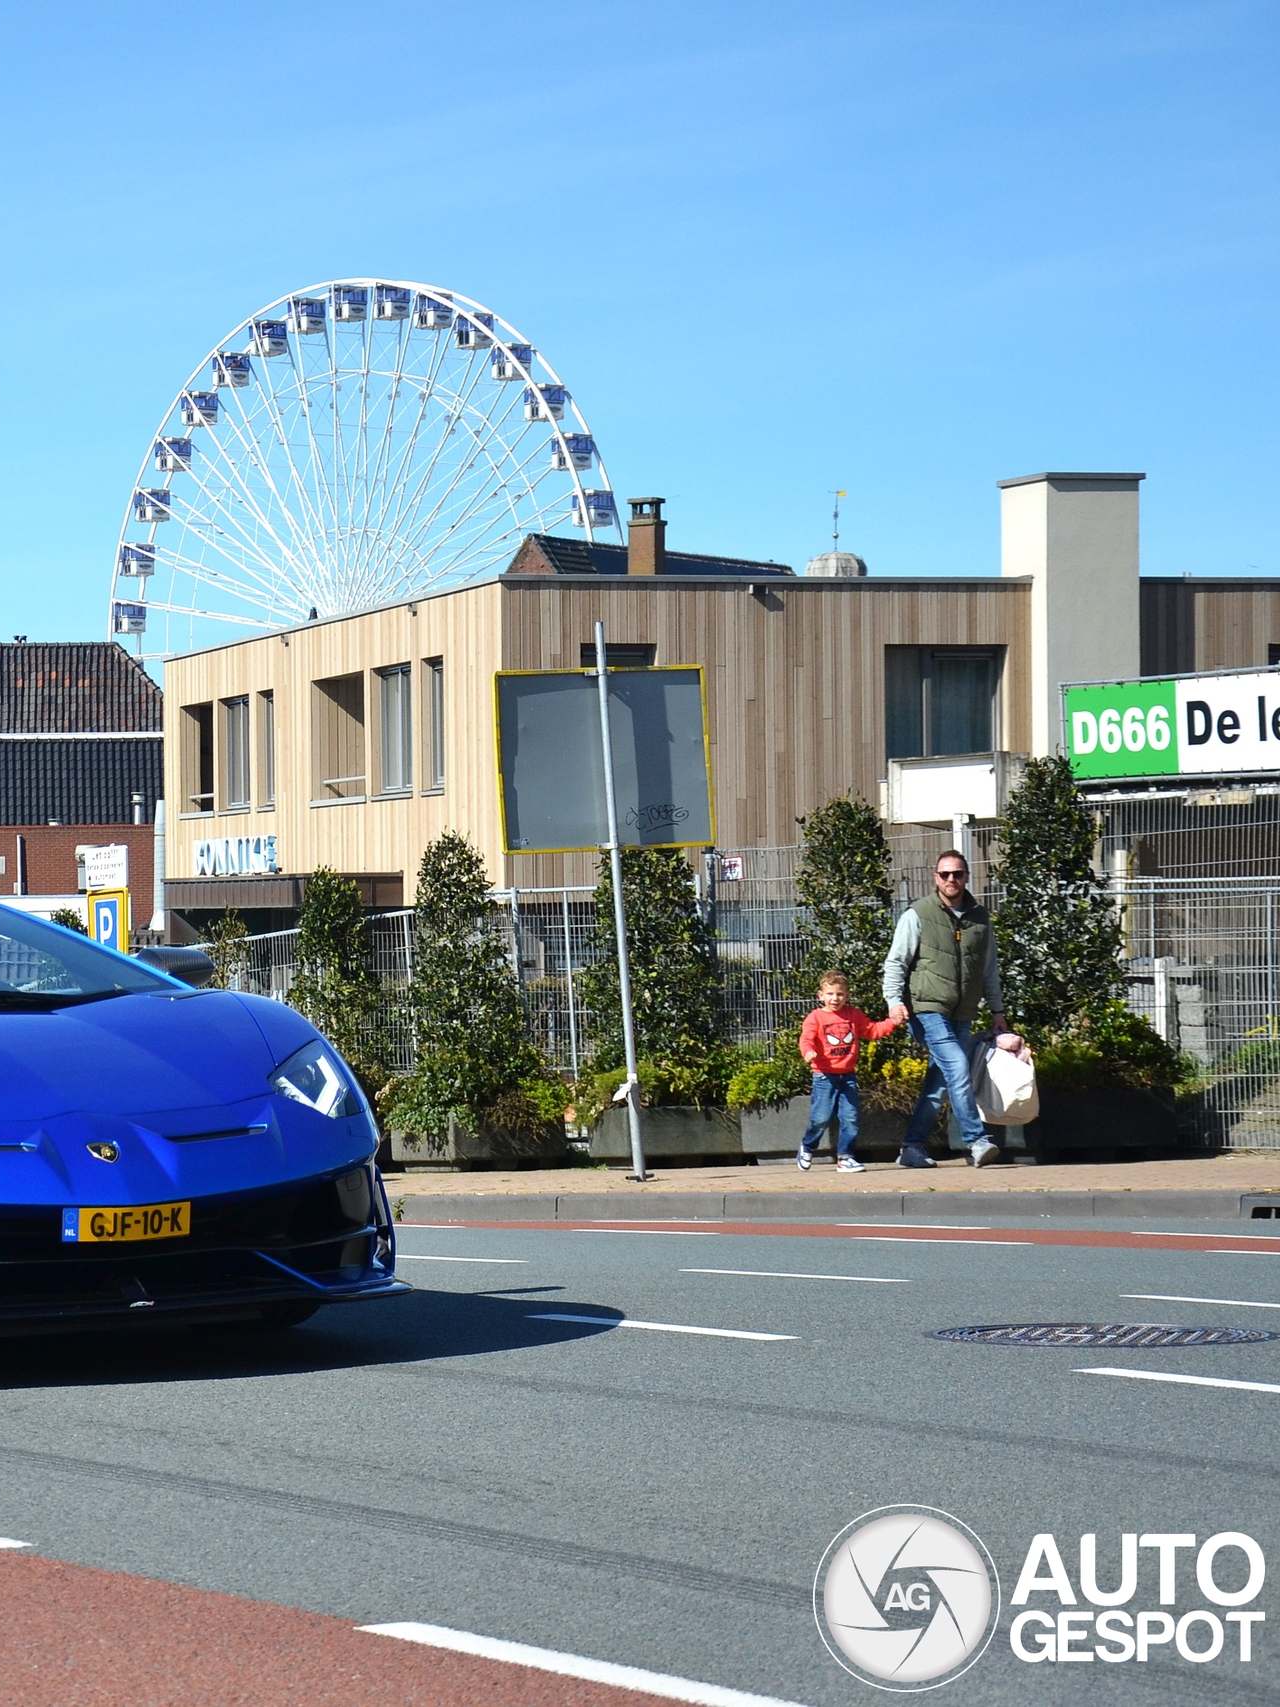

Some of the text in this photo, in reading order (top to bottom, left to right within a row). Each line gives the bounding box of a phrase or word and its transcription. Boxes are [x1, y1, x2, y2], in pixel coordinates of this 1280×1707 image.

[1072, 705, 1171, 755] D666
[1186, 700, 1241, 746] De
[91, 851, 102, 861] Let
[99, 907, 113, 946] P
[65, 1229, 76, 1237] NL
[90, 1207, 182, 1238] GJF-10-K
